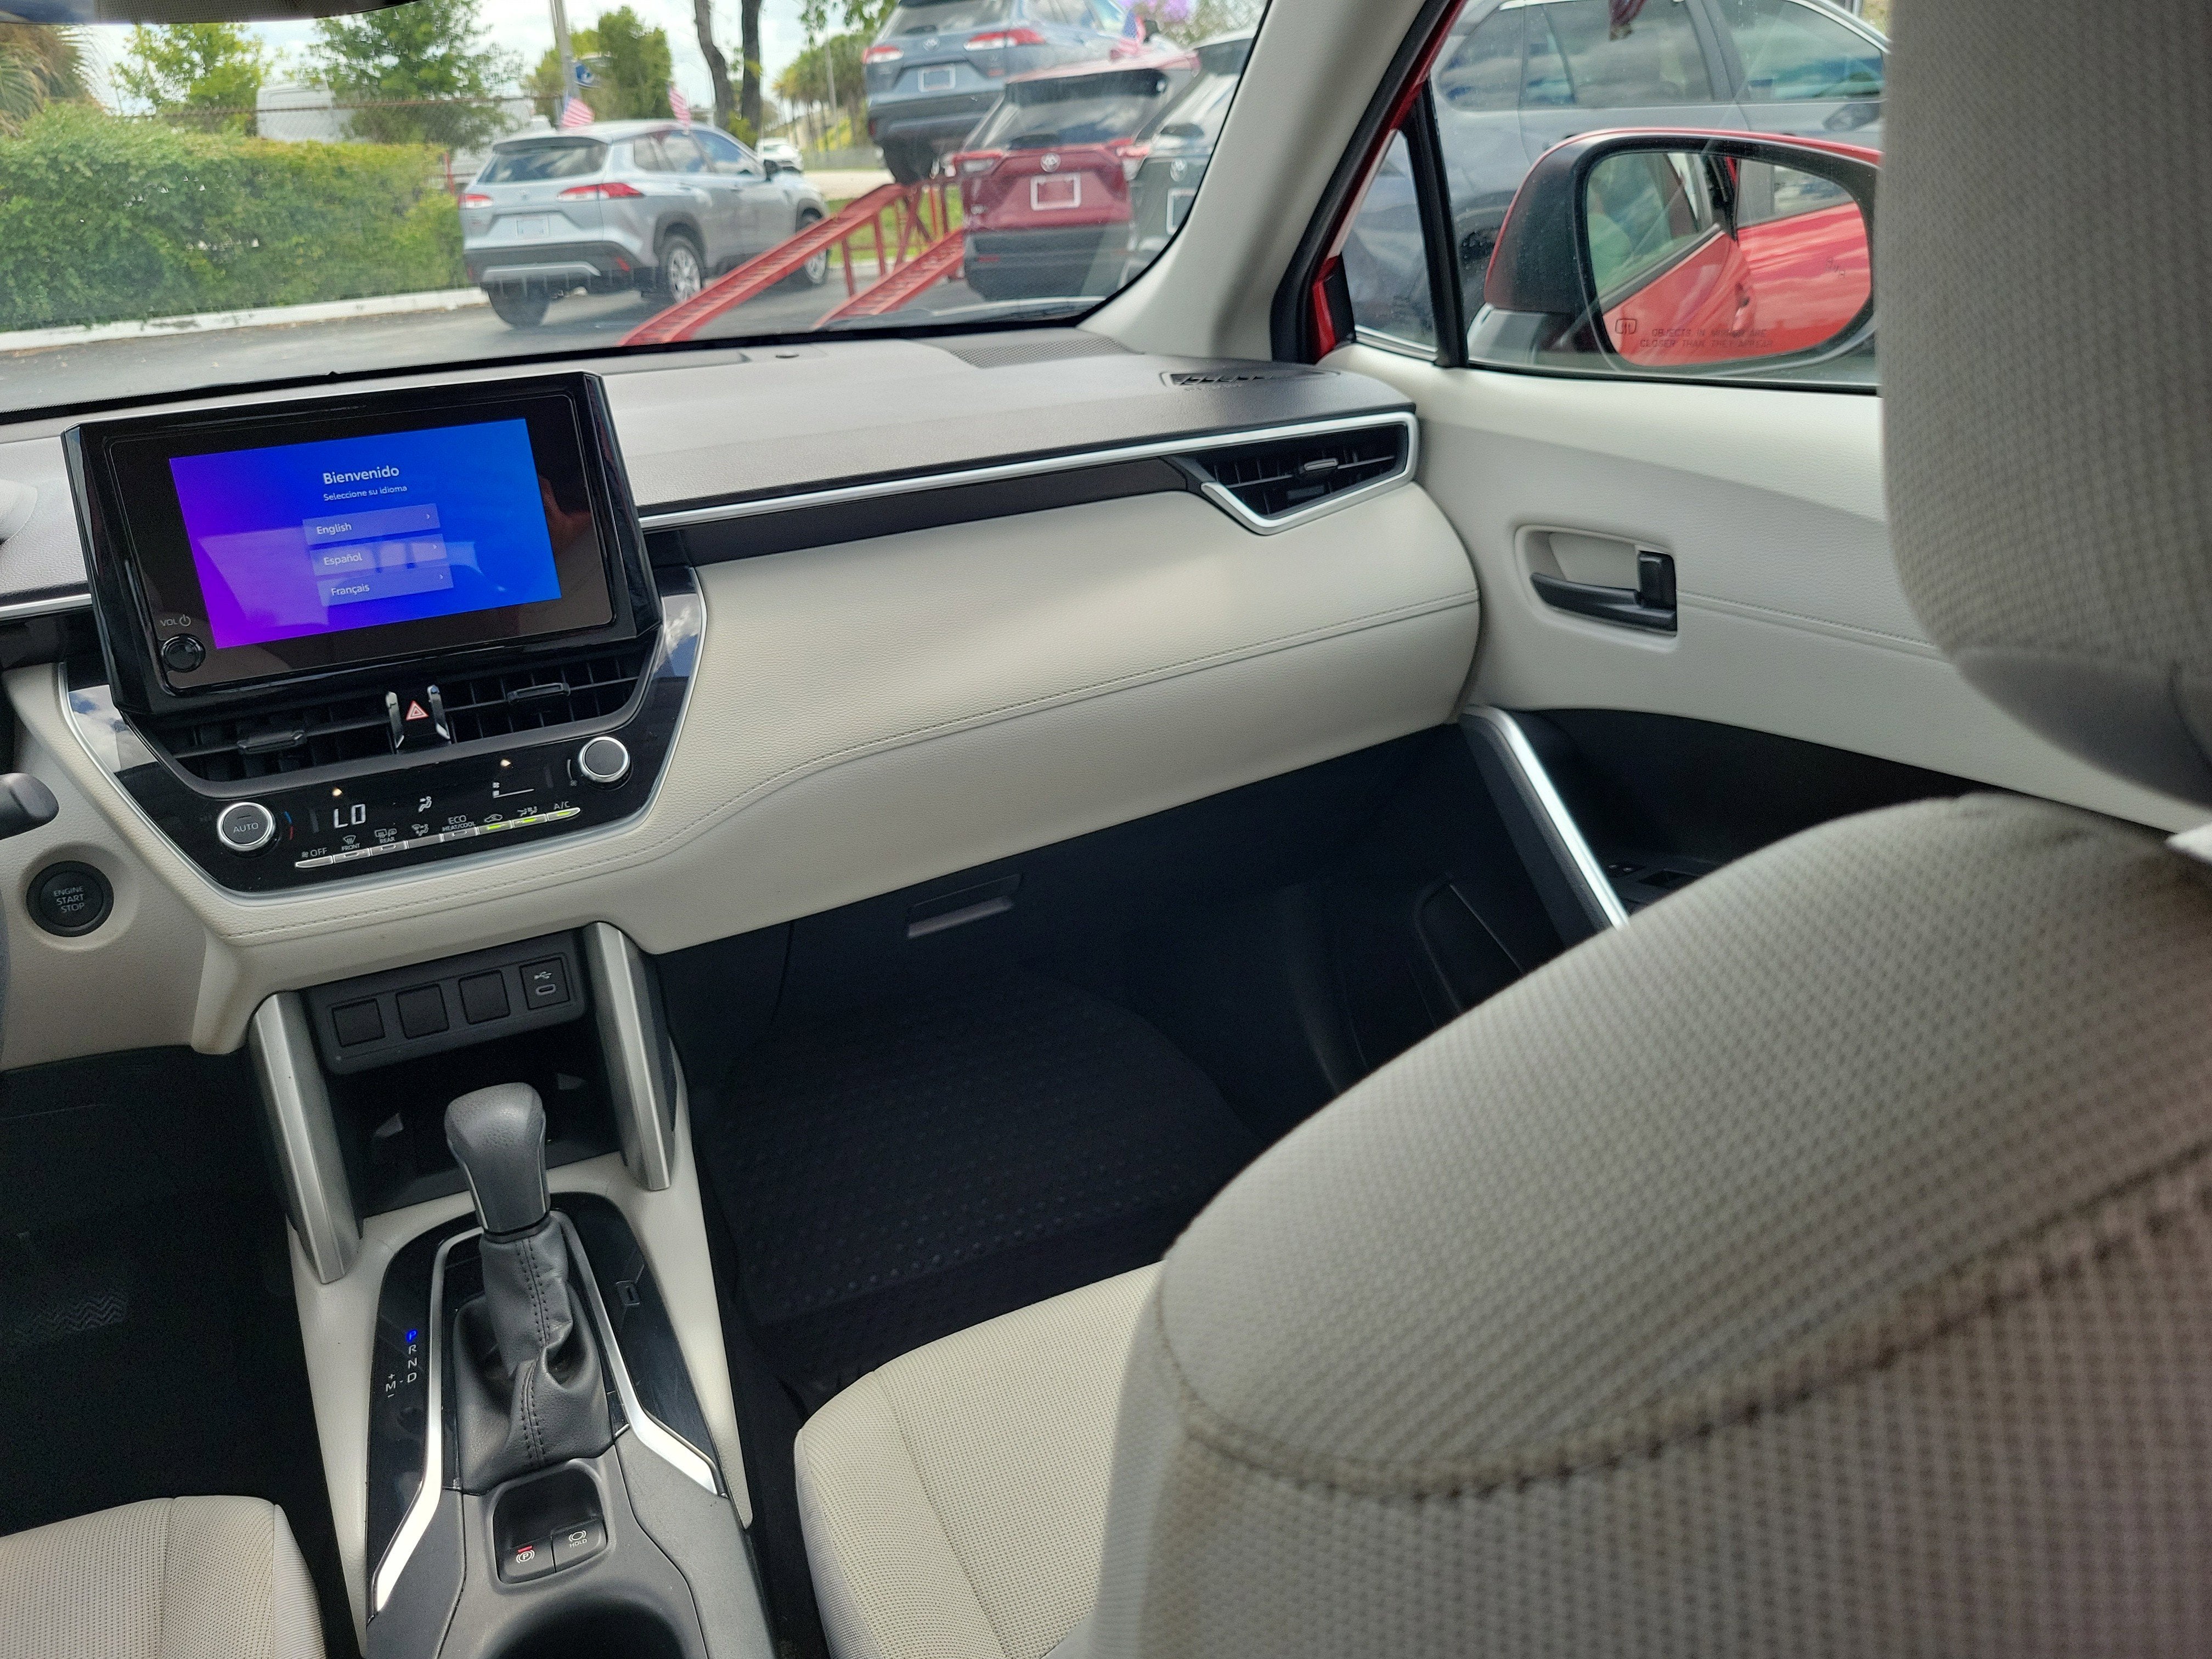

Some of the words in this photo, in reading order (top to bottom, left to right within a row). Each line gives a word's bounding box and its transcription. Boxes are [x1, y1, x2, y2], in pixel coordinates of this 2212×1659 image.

[323, 465, 400, 484] Bienvenido
[323, 490, 368, 501] Seleccione
[380, 486, 408, 494] idioma
[317, 522, 352, 535] English
[324, 552, 363, 566] Español
[331, 583, 370, 596] Français
[553, 801, 571, 810] A/C
[447, 815, 467, 825] ECO
[233, 822, 259, 834] AUTO
[442, 821, 476, 832] HEAT/COOL
[310, 847, 328, 856] OFF
[341, 843, 360, 851] FRONT
[54, 885, 83, 897] ENGINE
[56, 894, 84, 906] START
[60, 902, 85, 913] STOP
[408, 1329, 417, 1341] P
[408, 1344, 417, 1355] R
[408, 1357, 417, 1369] N
[407, 1372, 417, 1383] D
[386, 1380, 396, 1392] M
[569, 1538, 588, 1548] HOLD
